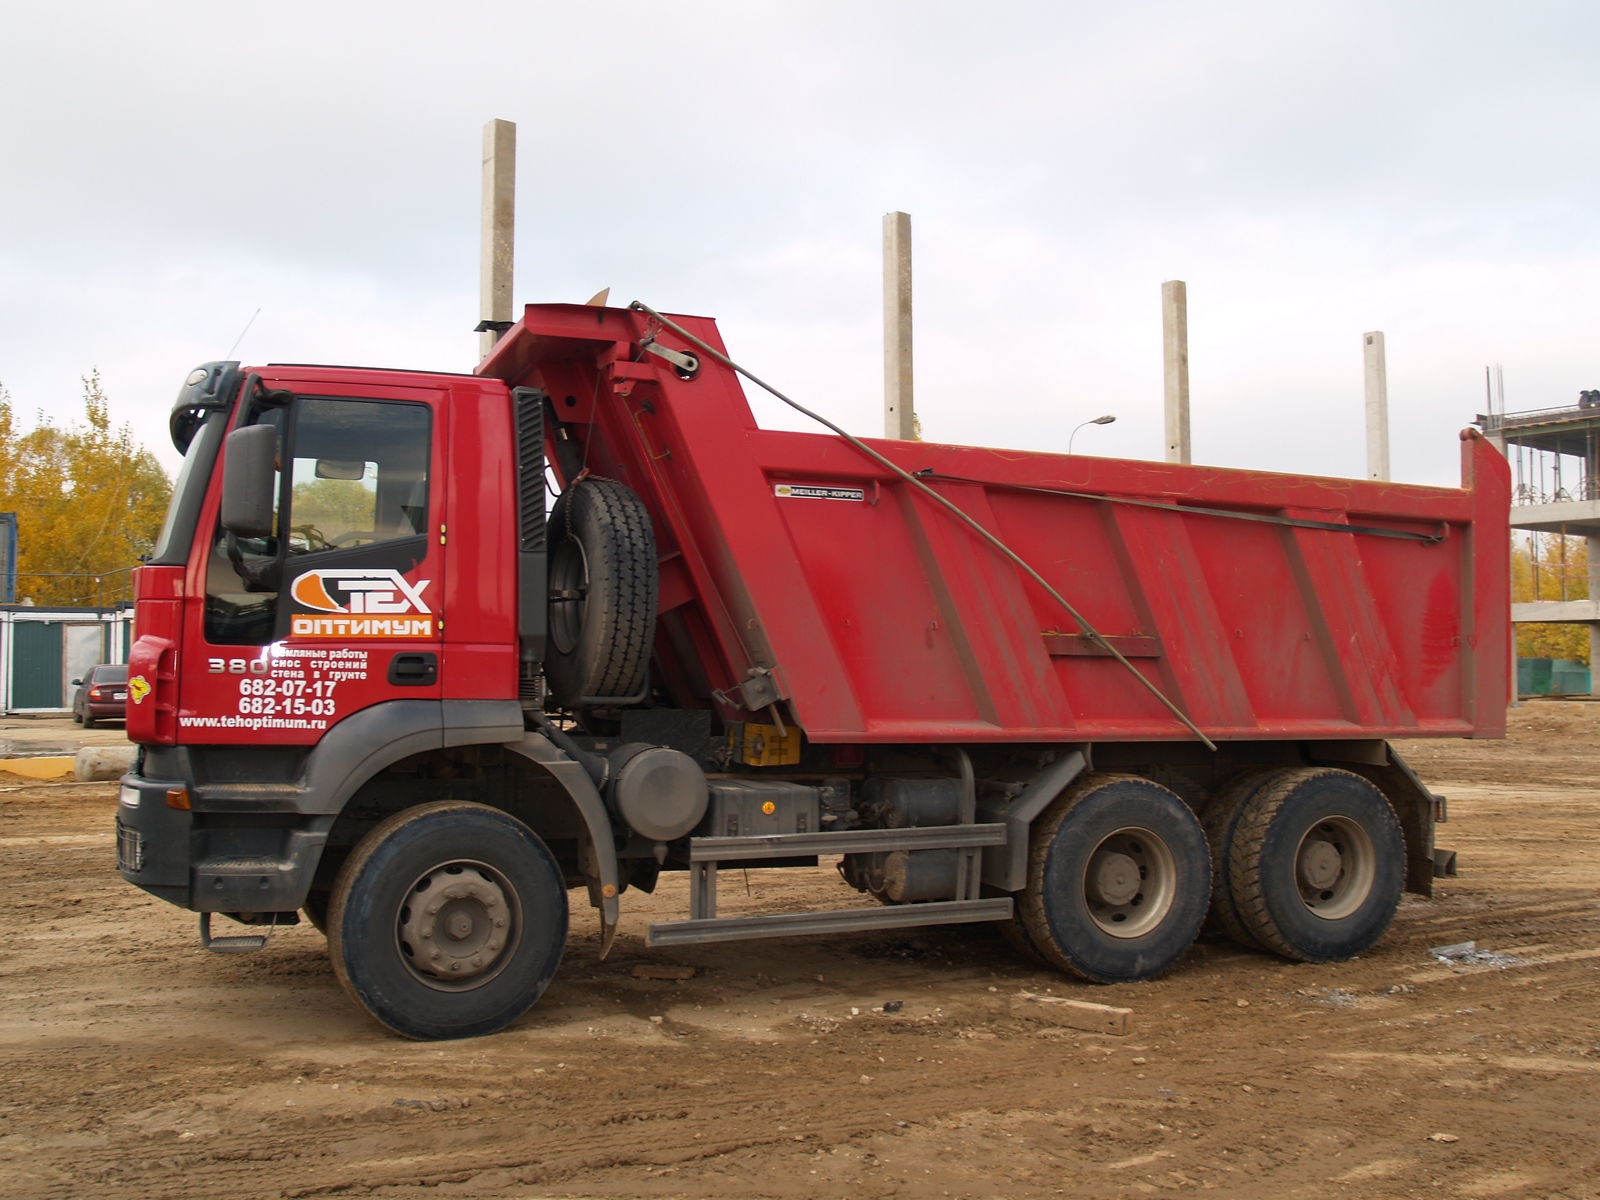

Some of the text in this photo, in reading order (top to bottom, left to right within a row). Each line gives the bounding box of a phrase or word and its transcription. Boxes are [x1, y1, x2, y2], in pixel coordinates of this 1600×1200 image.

[791, 488, 863, 498] MEILLER-KIPPER
[293, 619, 432, 635] ОПТИМУМ
[329, 648, 368, 660] работы
[208, 658, 268, 674] 380
[272, 659, 368, 670] снос строений
[271, 669, 367, 681] стена в грунте
[239, 679, 336, 697] 682-07-17
[239, 698, 335, 715] 682-15-03
[180, 715, 326, 730] www.tehoptimum.ru
